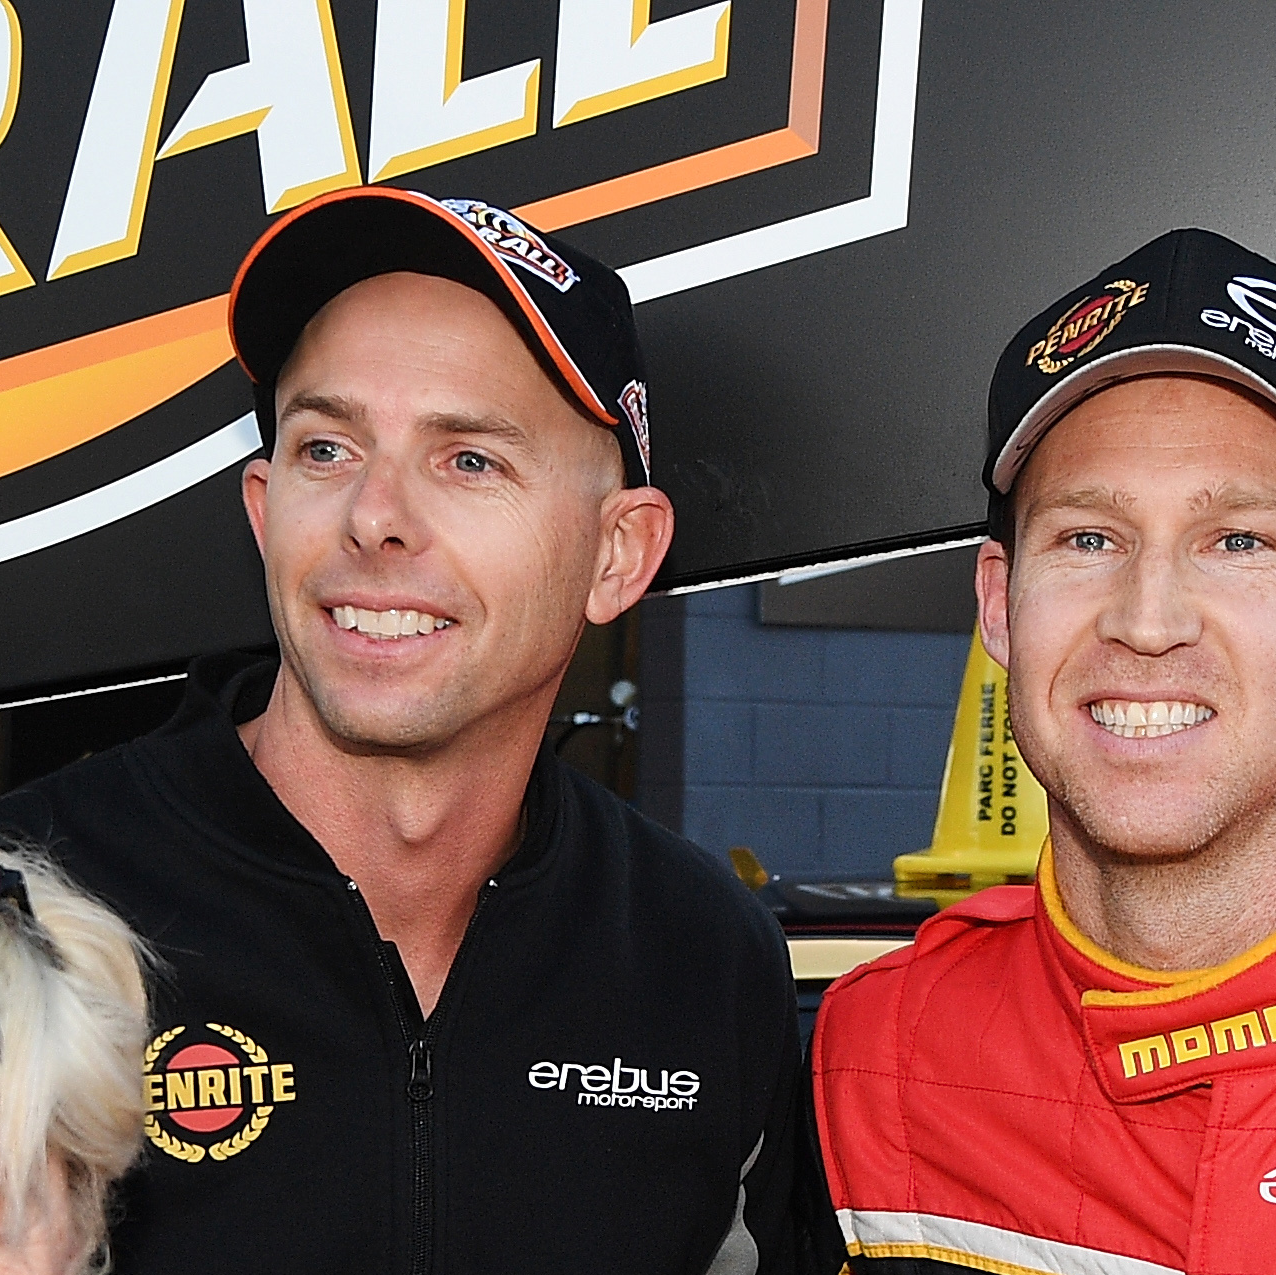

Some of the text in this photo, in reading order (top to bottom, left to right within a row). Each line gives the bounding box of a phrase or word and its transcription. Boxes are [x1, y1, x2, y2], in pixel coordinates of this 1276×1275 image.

[1026, 282, 1150, 367] PENRITE
[978, 682, 997, 822] PARC FERME
[1002, 753, 1018, 798] NOT
[1001, 806, 1017, 836] DO
[529, 1058, 701, 1095] erebus
[578, 1092, 698, 1113] motorsport
